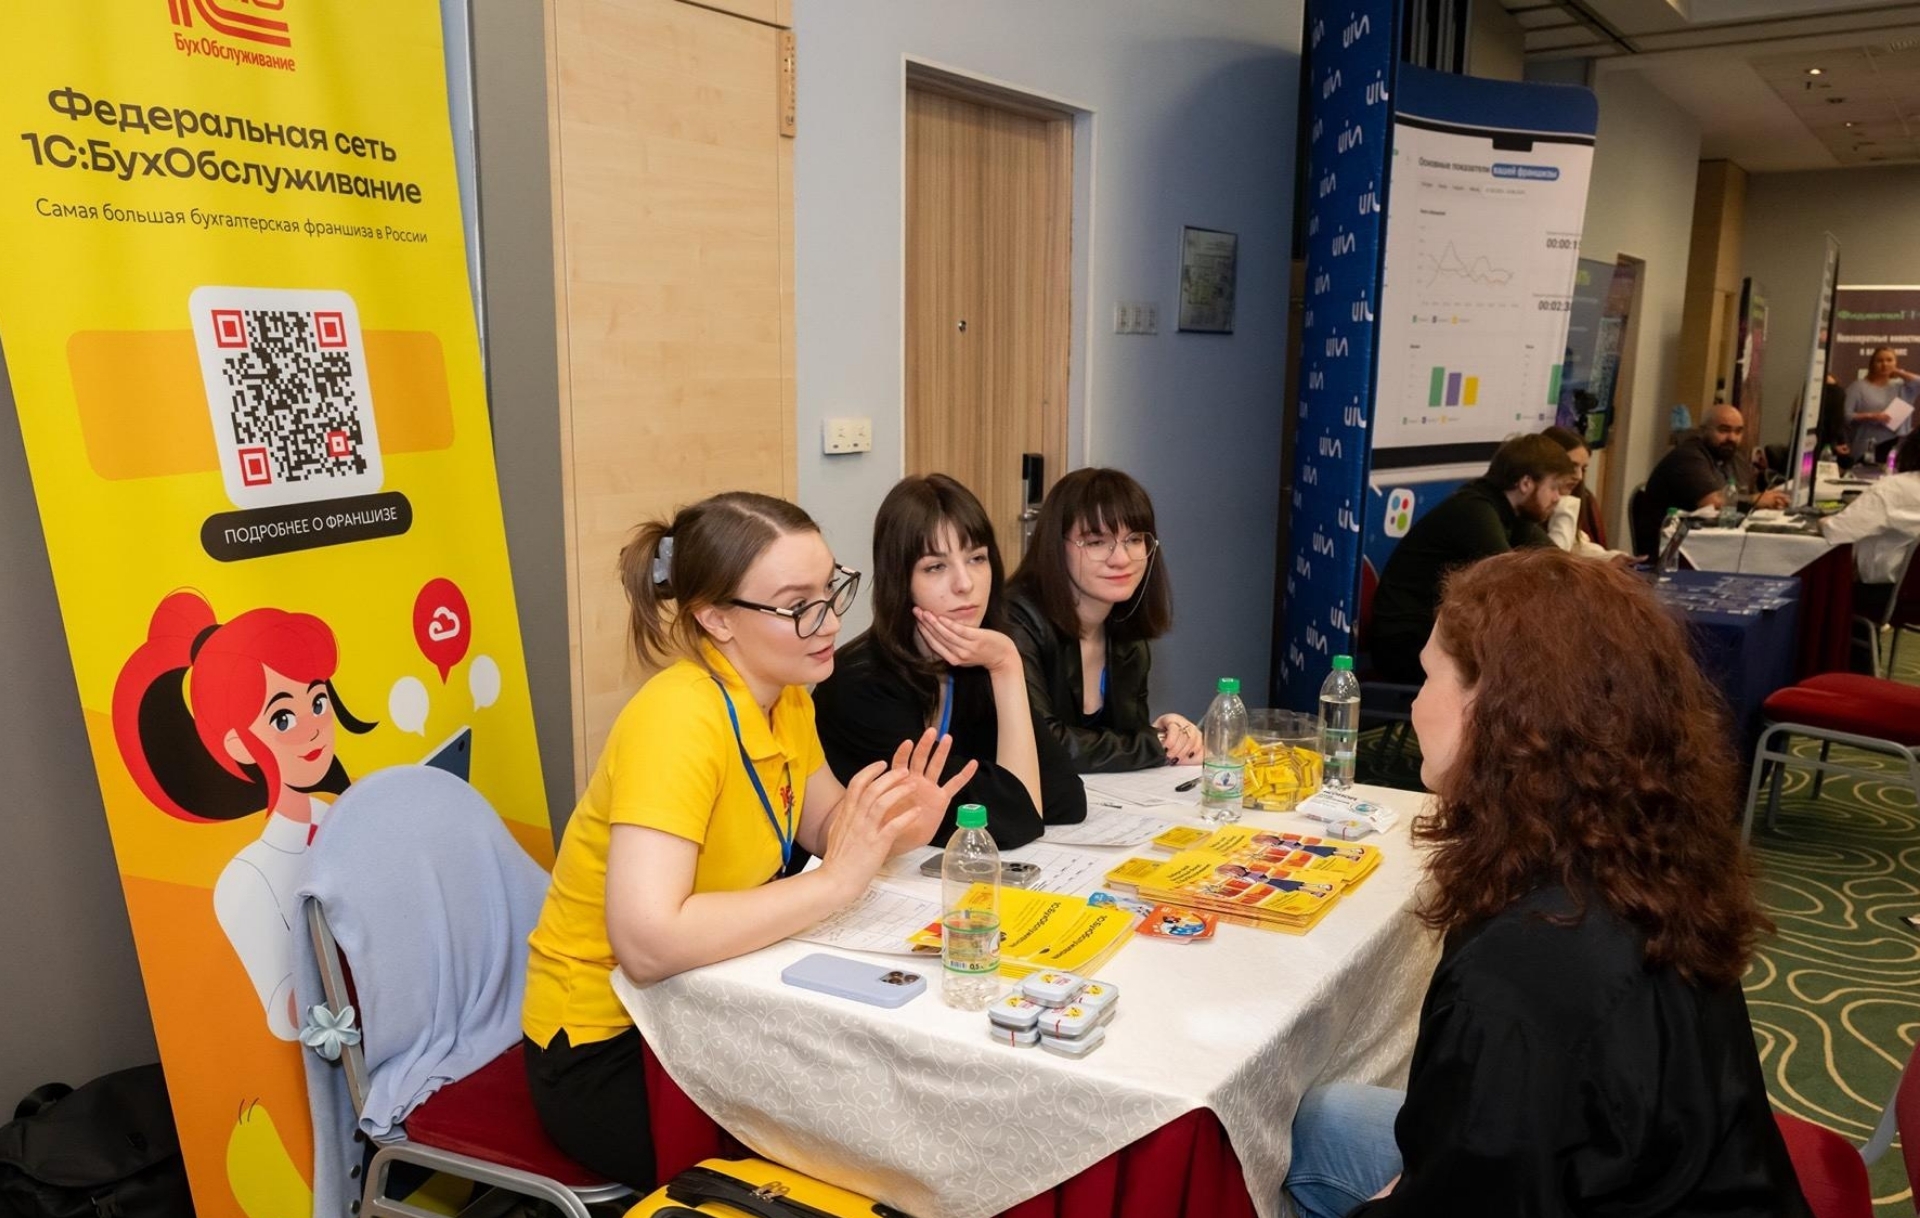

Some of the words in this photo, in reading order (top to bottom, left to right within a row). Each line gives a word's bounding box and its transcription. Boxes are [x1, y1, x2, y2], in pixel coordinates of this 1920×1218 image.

[174, 32, 295, 72] БухОбслуживание
[48, 86, 327, 151] Федеральная
[335, 132, 397, 162] сеть
[21, 132, 422, 204] 1С:БухОбслуживание
[36, 198, 99, 220] Самая
[103, 204, 186, 225] большая
[191, 207, 300, 234] бухгалтерская
[304, 218, 374, 240] франшиза
[376, 229, 383, 240] в
[386, 226, 428, 244] России
[225, 519, 309, 544] ПОДРОБНЕЕ
[312, 517, 324, 531] О
[325, 507, 398, 530] ФРАНШИЗЕ
